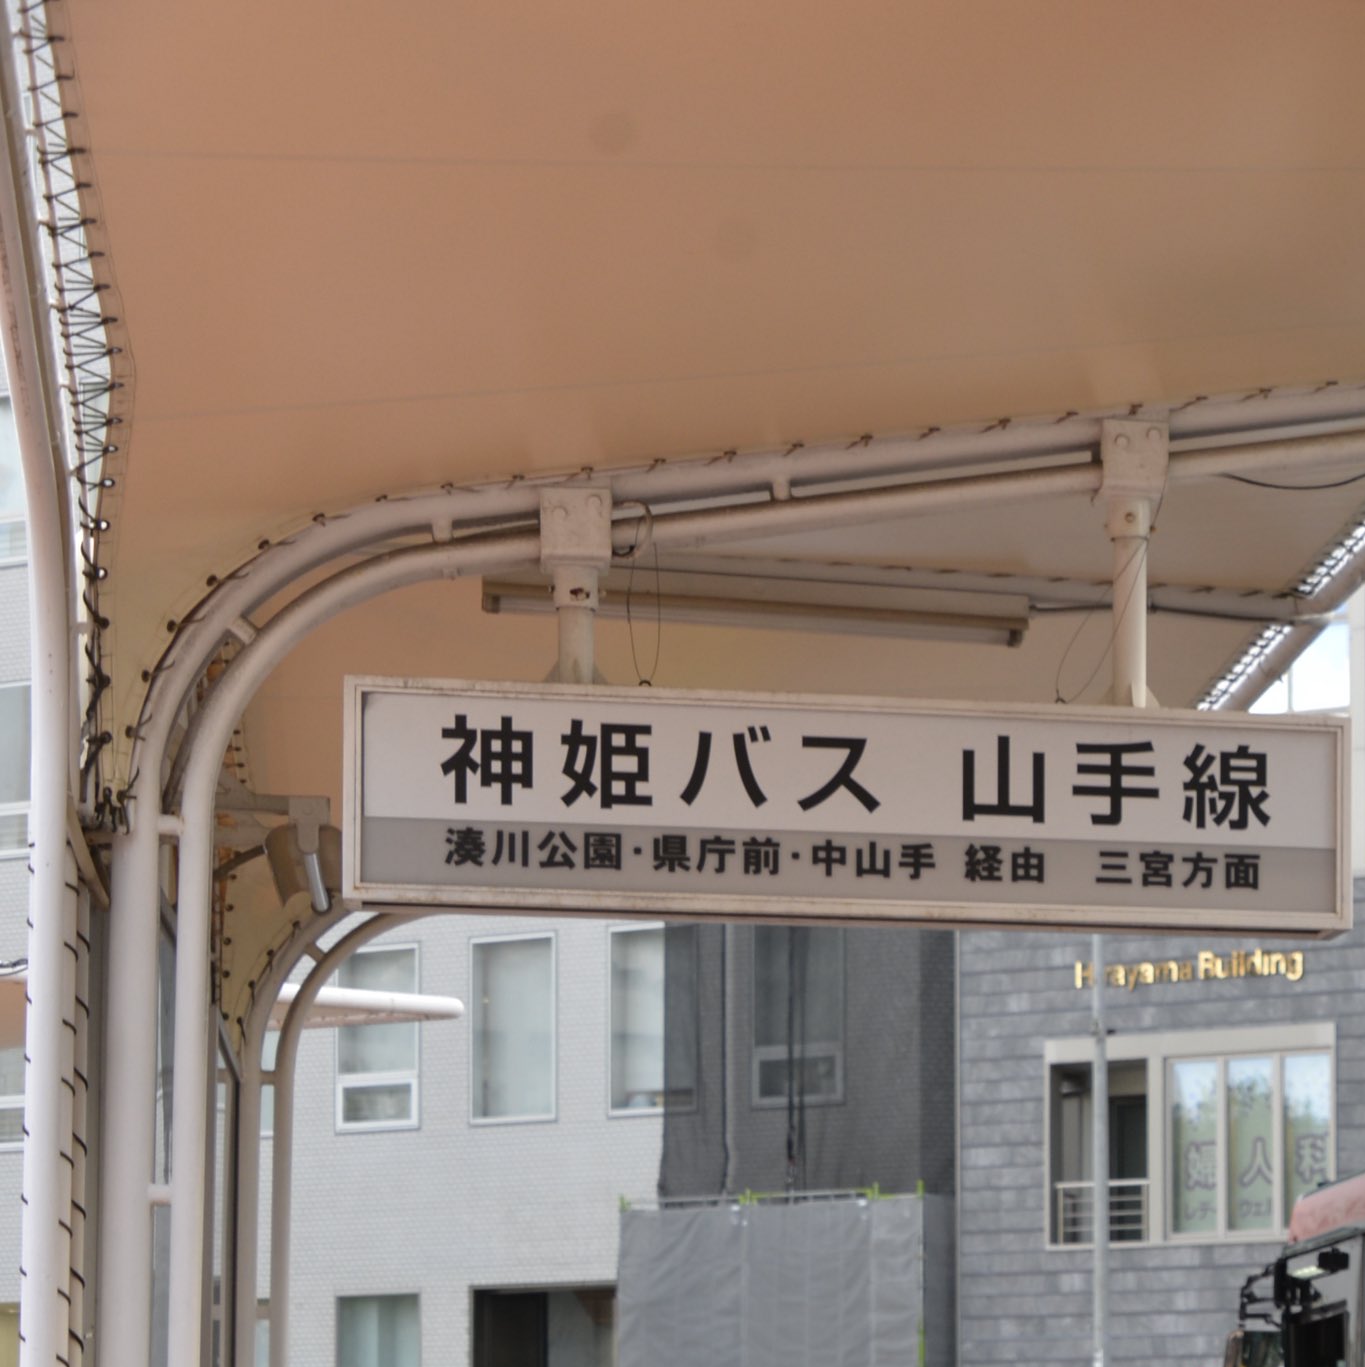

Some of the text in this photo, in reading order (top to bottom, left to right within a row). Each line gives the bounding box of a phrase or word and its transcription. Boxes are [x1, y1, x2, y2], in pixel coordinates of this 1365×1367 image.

[440, 714, 1271, 831] 神姫バス 山手線
[444, 827, 1261, 892] 湊川公園・県庁前・中山手 経由 三宮方面
[1074, 947, 1305, 991] Hrayama Building
